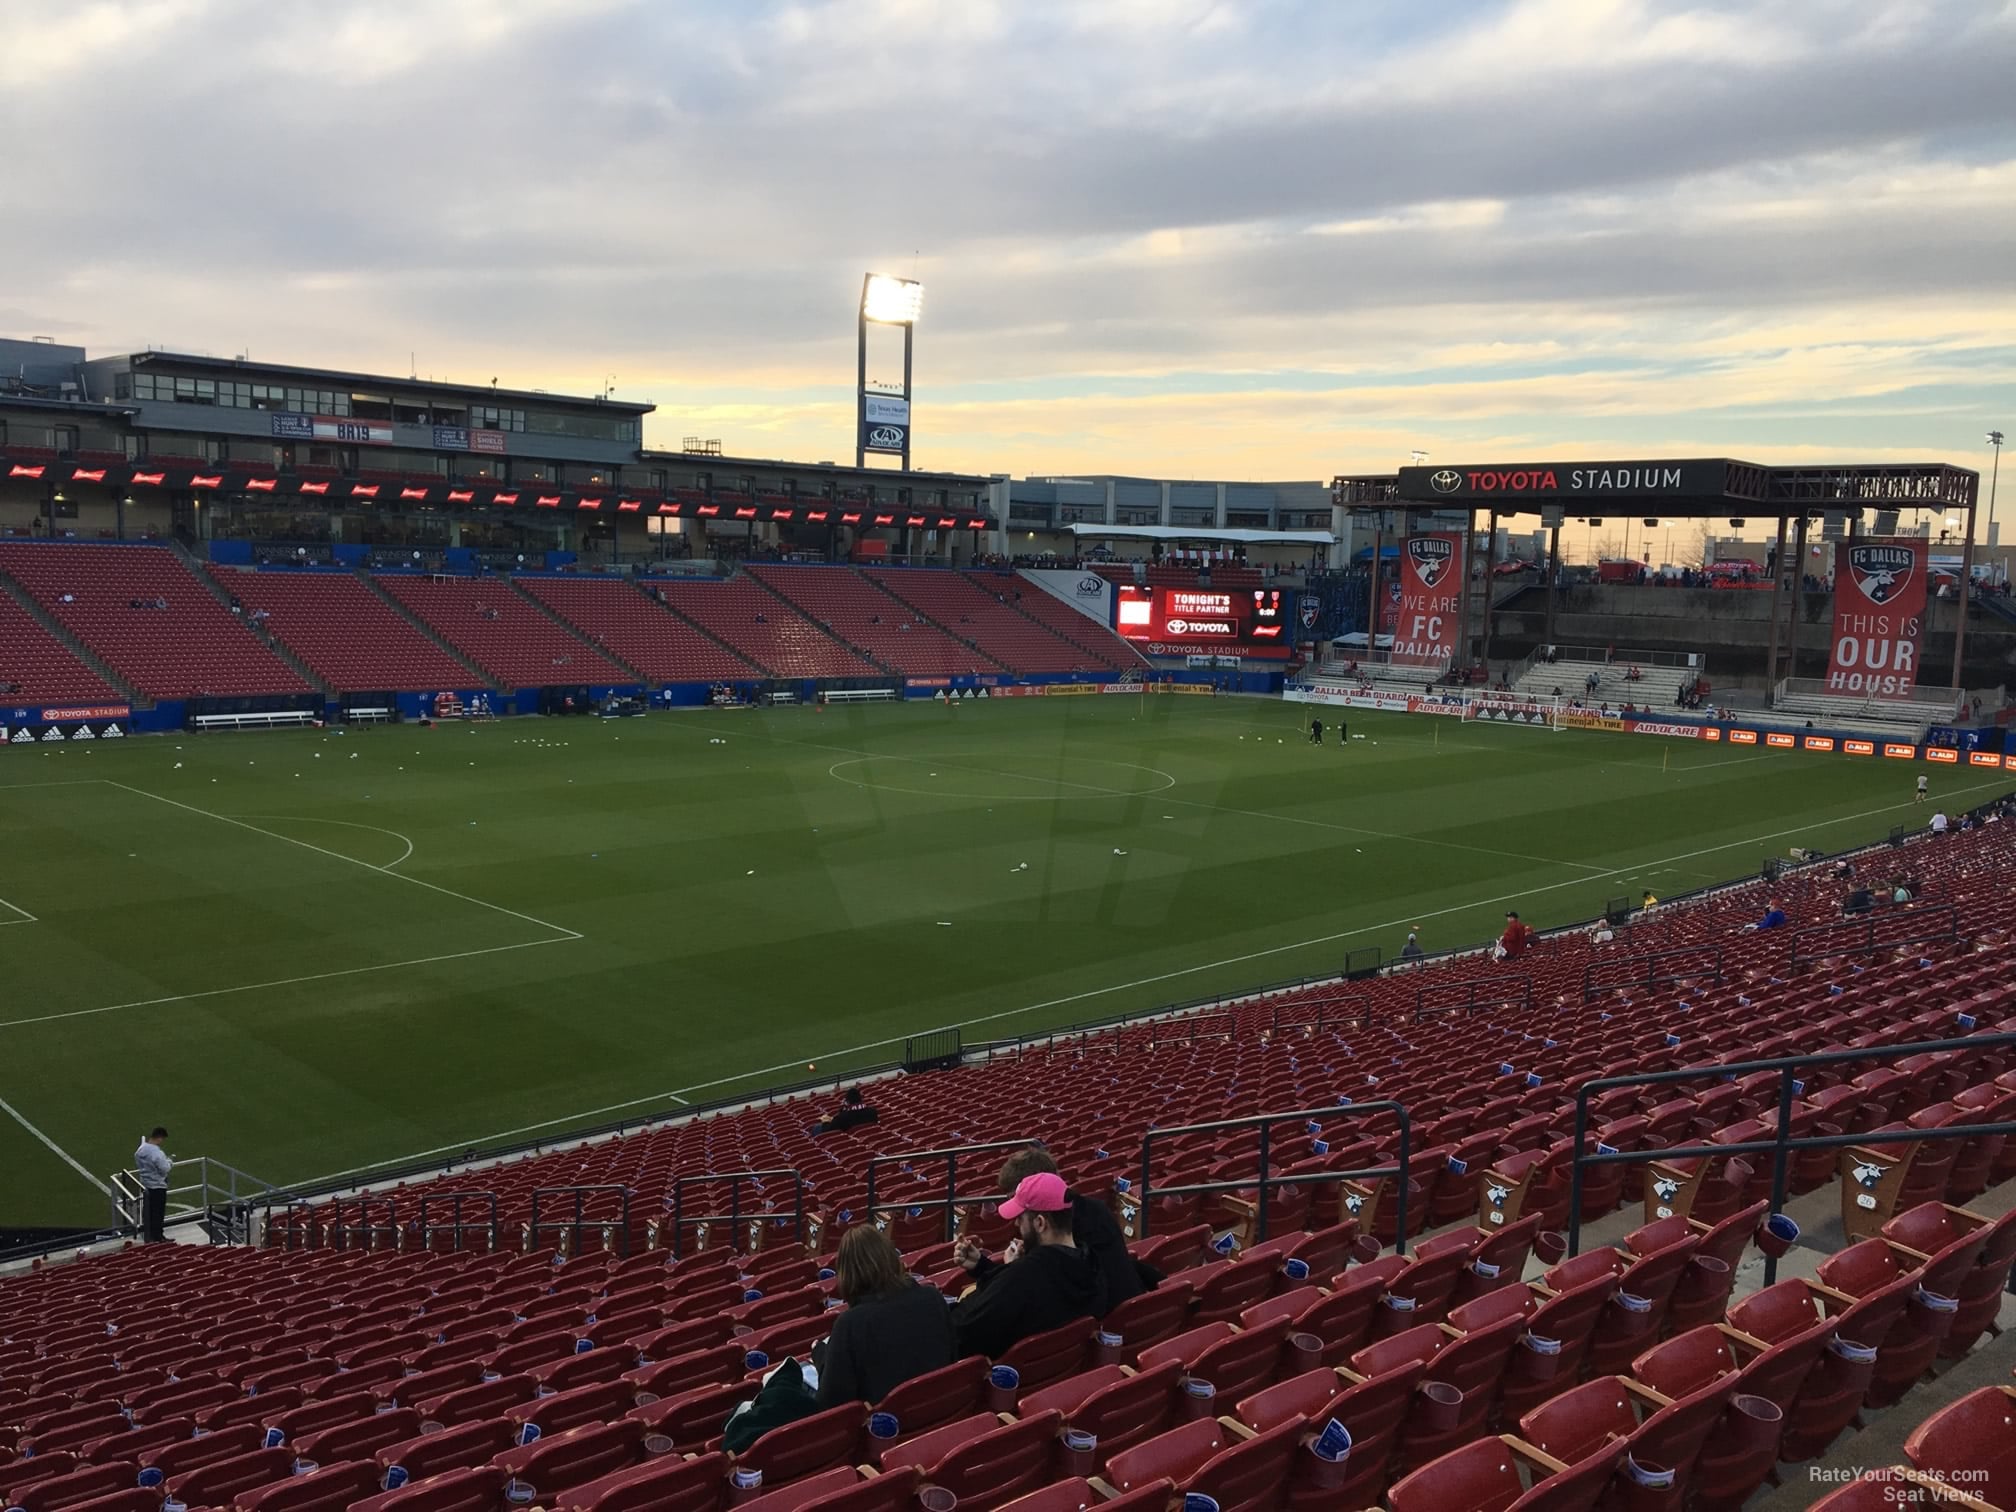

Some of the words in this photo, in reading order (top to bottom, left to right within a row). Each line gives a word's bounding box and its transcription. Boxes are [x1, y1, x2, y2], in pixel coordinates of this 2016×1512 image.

[1467, 470, 1558, 491] TOYOTA
[1570, 468, 1681, 489] STADIUM
[1412, 541, 1421, 553] FC
[1423, 541, 1450, 554] DALLAS
[1854, 549, 1866, 564] FC
[1871, 549, 1909, 565] DALLAS
[1173, 594, 1231, 606] TONIGHT'S
[1404, 595, 1426, 611] WE
[1429, 597, 1459, 613] ARE
[1174, 604, 1194, 613] TITLE
[1195, 605, 1230, 614] PARTNER
[1188, 623, 1230, 633] TOYOTA
[1411, 615, 1442, 641] FC
[1840, 613, 1889, 635] THIS
[1900, 617, 1919, 637] IS
[1166, 645, 1203, 655] TOYOTA
[1207, 646, 1249, 656] STADIUM
[1394, 641, 1452, 658] DALLAS
[1836, 636, 1914, 672] OUR
[1104, 684, 1143, 693] ADVOCARE
[1830, 671, 1911, 696] HOUSE
[1306, 693, 1329, 701] TOYOTA
[1315, 686, 1348, 697] DALLAS
[1350, 689, 1372, 698] BEER
[1373, 691, 1424, 704] GUARDIANS
[1472, 699, 1509, 711] DALLAS
[61, 710, 91, 718] TOYOTA
[94, 707, 129, 717] STADIUM
[1604, 720, 1622, 729] TIRE
[1635, 723, 1699, 737] ADVOCARE
[41, 733, 65, 742] adidas
[72, 732, 96, 740] adidas
[101, 730, 124, 739] adidas
[1859, 1195, 1872, 1206] 26
